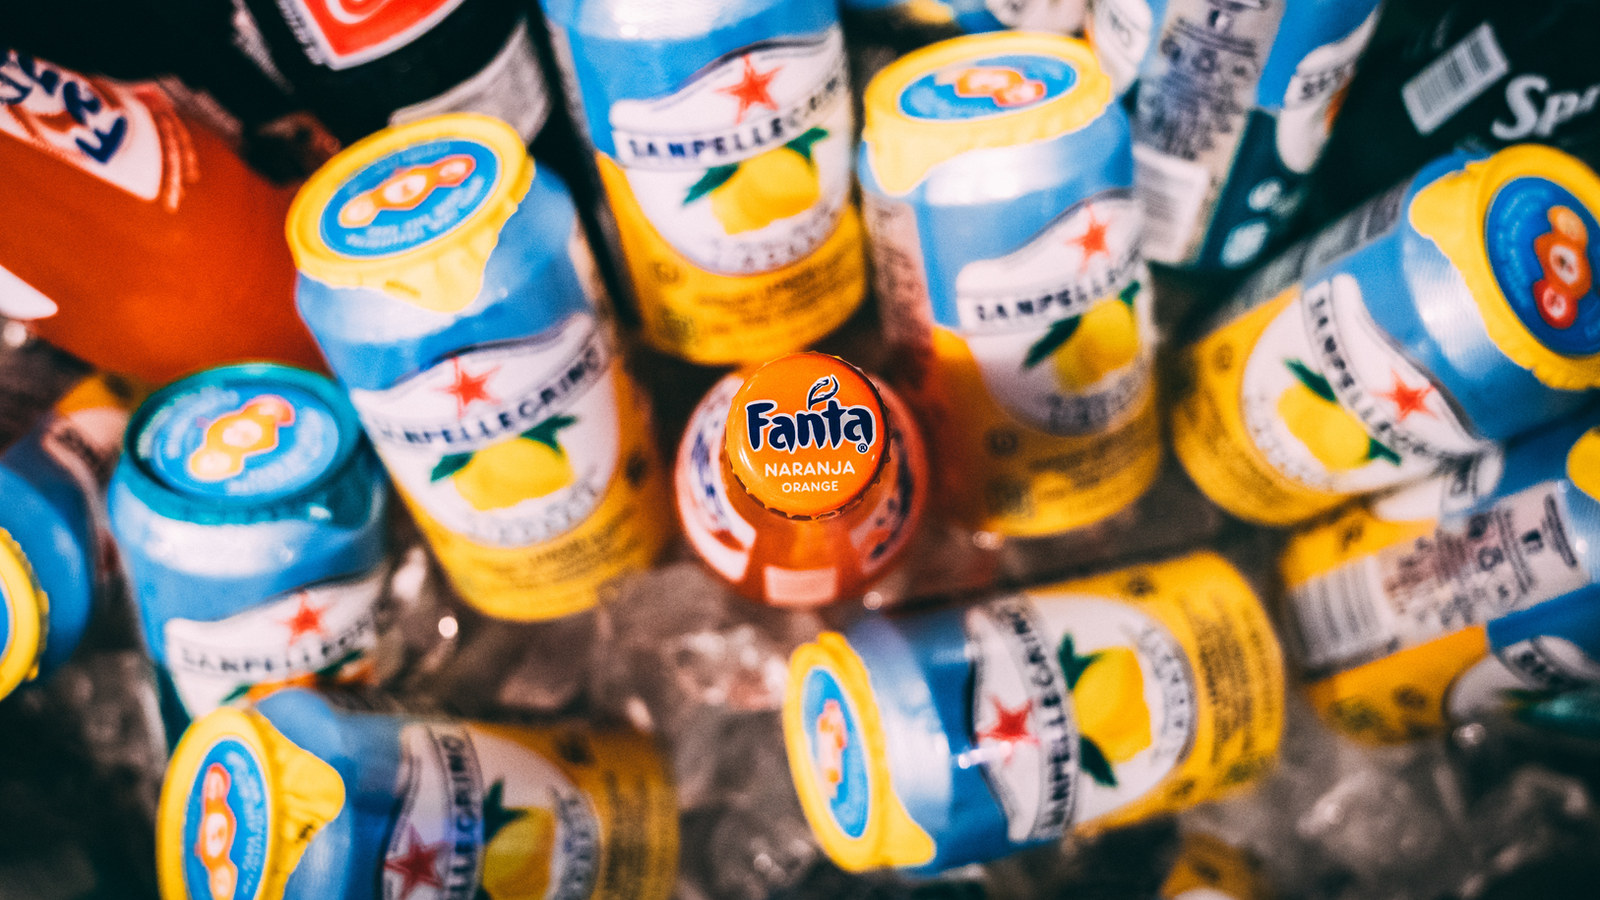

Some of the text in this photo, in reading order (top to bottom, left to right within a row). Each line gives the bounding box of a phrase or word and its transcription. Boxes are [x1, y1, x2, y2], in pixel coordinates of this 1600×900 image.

[746, 399, 876, 454] Fanta
[764, 460, 856, 477] NARANJA
[781, 481, 839, 493] ORANGE
